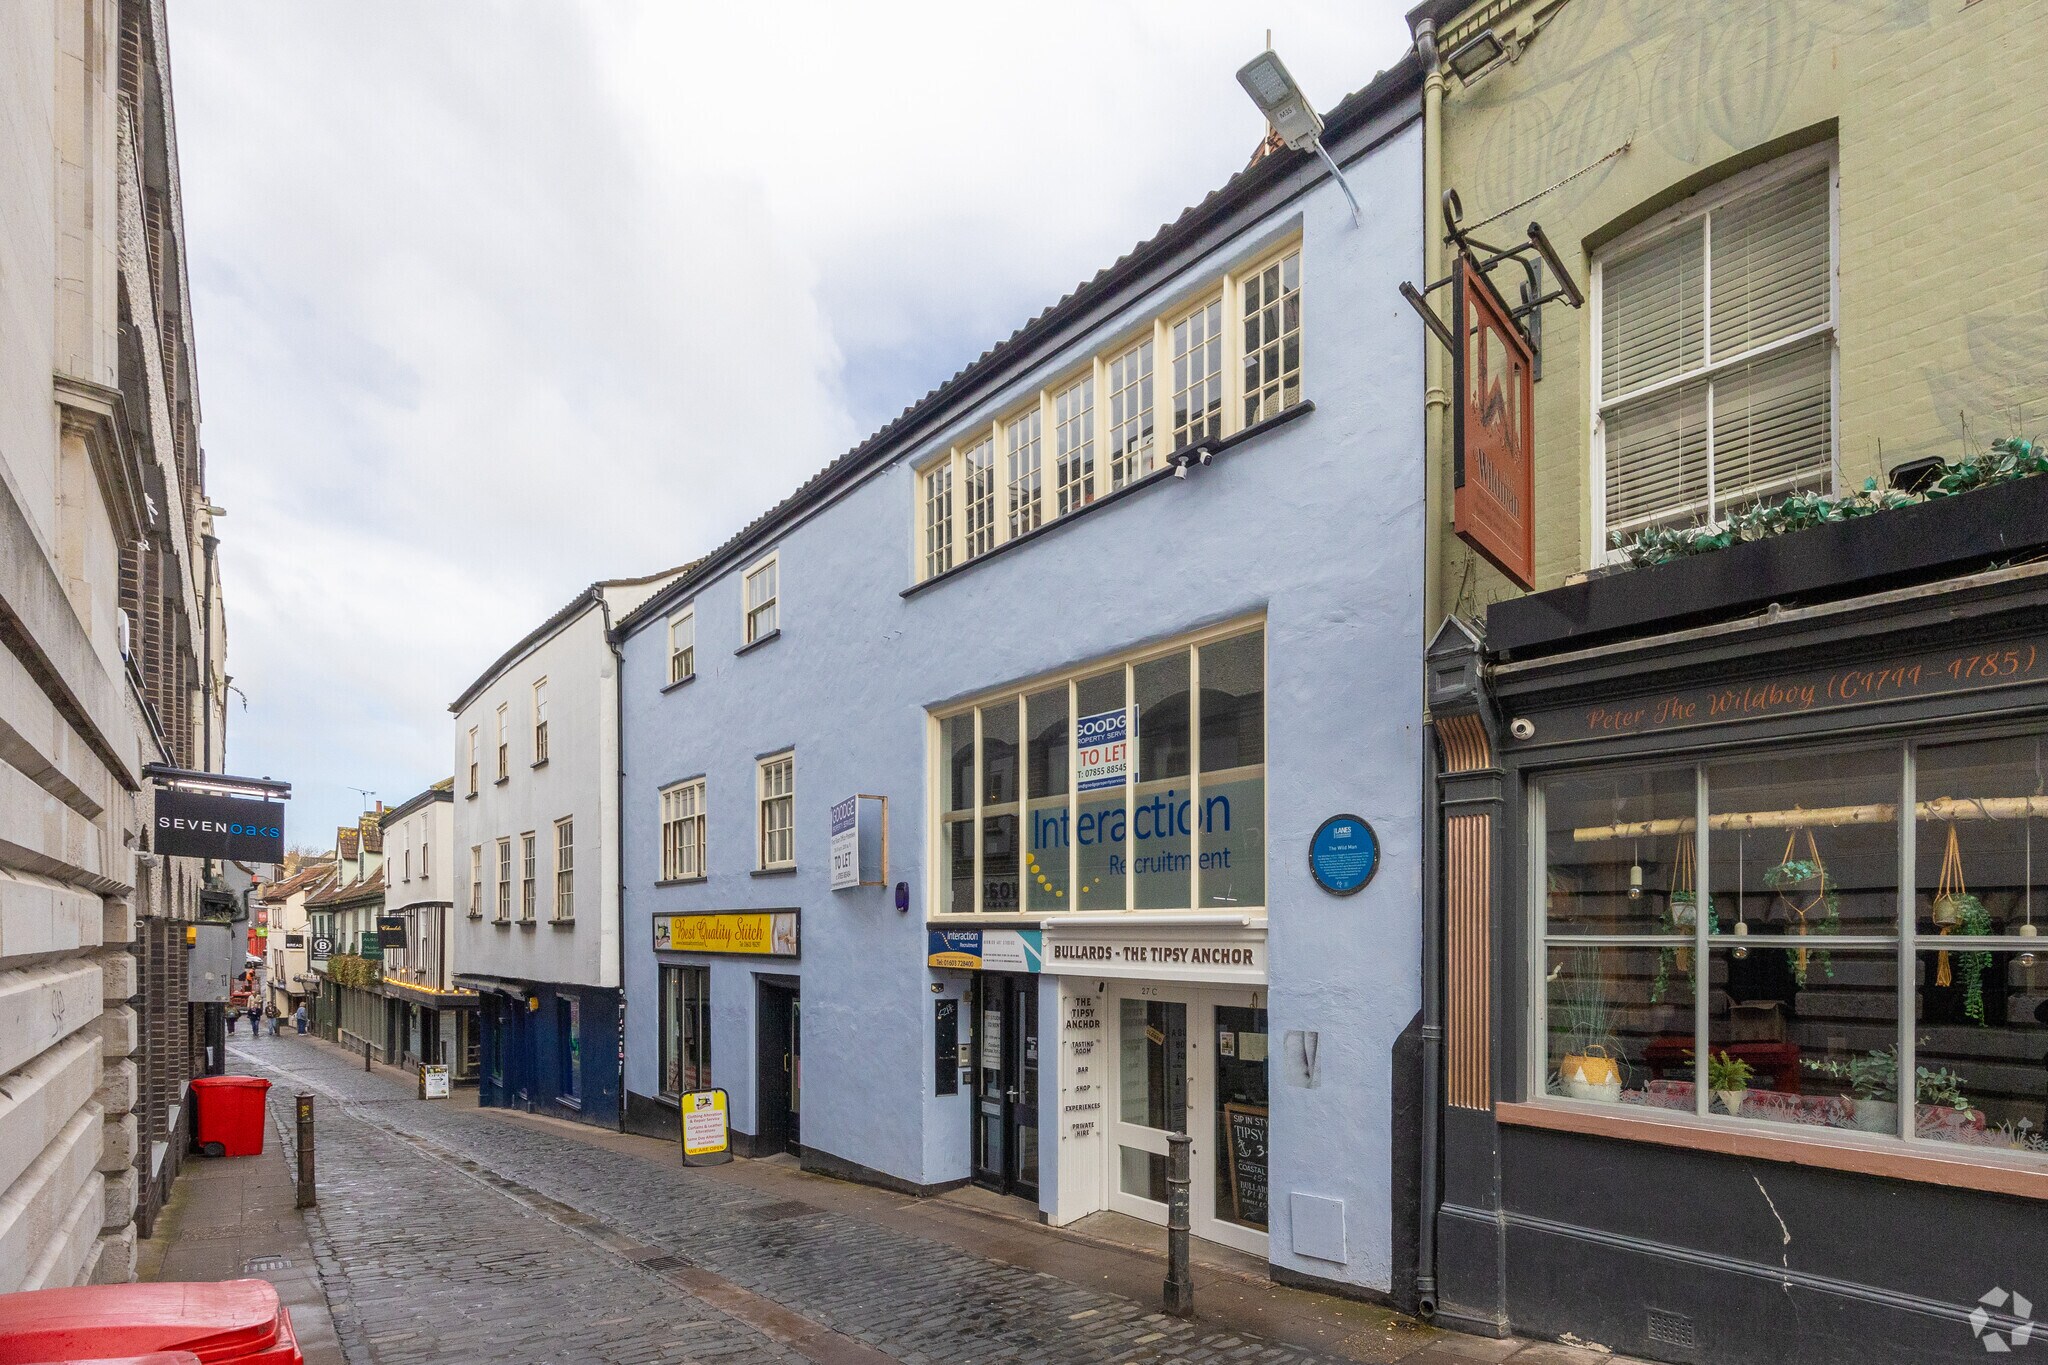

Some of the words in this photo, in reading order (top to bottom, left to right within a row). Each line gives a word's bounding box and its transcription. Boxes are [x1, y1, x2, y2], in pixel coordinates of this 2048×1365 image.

[1587, 707, 1645, 730] Peter
[1654, 694, 1696, 724] The
[1708, 683, 1815, 716] Wildboy
[1948, 645, 2037, 681] 1785)
[1078, 715, 1126, 737] GOODG
[1080, 749, 1100, 766] TO
[1104, 744, 1126, 762] LET
[1085, 768, 1104, 778] 07855
[1106, 763, 1126, 774] 88545
[832, 799, 855, 824] GOODGE
[1034, 790, 1230, 850] Interaction
[834, 855, 842, 870] TO
[842, 852, 852, 868] LET
[1110, 847, 1231, 875] Recruitment
[675, 918, 696, 940] Best
[696, 918, 732, 948] Quality
[734, 916, 763, 941] Stitch
[946, 931, 978, 940] Interaction
[1054, 945, 1112, 960] BULLARDS
[1123, 946, 1148, 961] THE
[1150, 948, 1189, 963] TIPSY
[1190, 948, 1254, 964] ANCHOR
[1076, 998, 1091, 1006] THE
[1072, 1009, 1095, 1017] TIPSY
[1066, 1020, 1100, 1028] ANCHOR
[1065, 1103, 1100, 1111] EXPERIENCES
[1245, 1116, 1253, 1124] IN
[1255, 1118, 1268, 1126] STY
[1234, 1125, 1264, 1141] TIPSY
[1238, 1164, 1266, 1175] COASTAL
